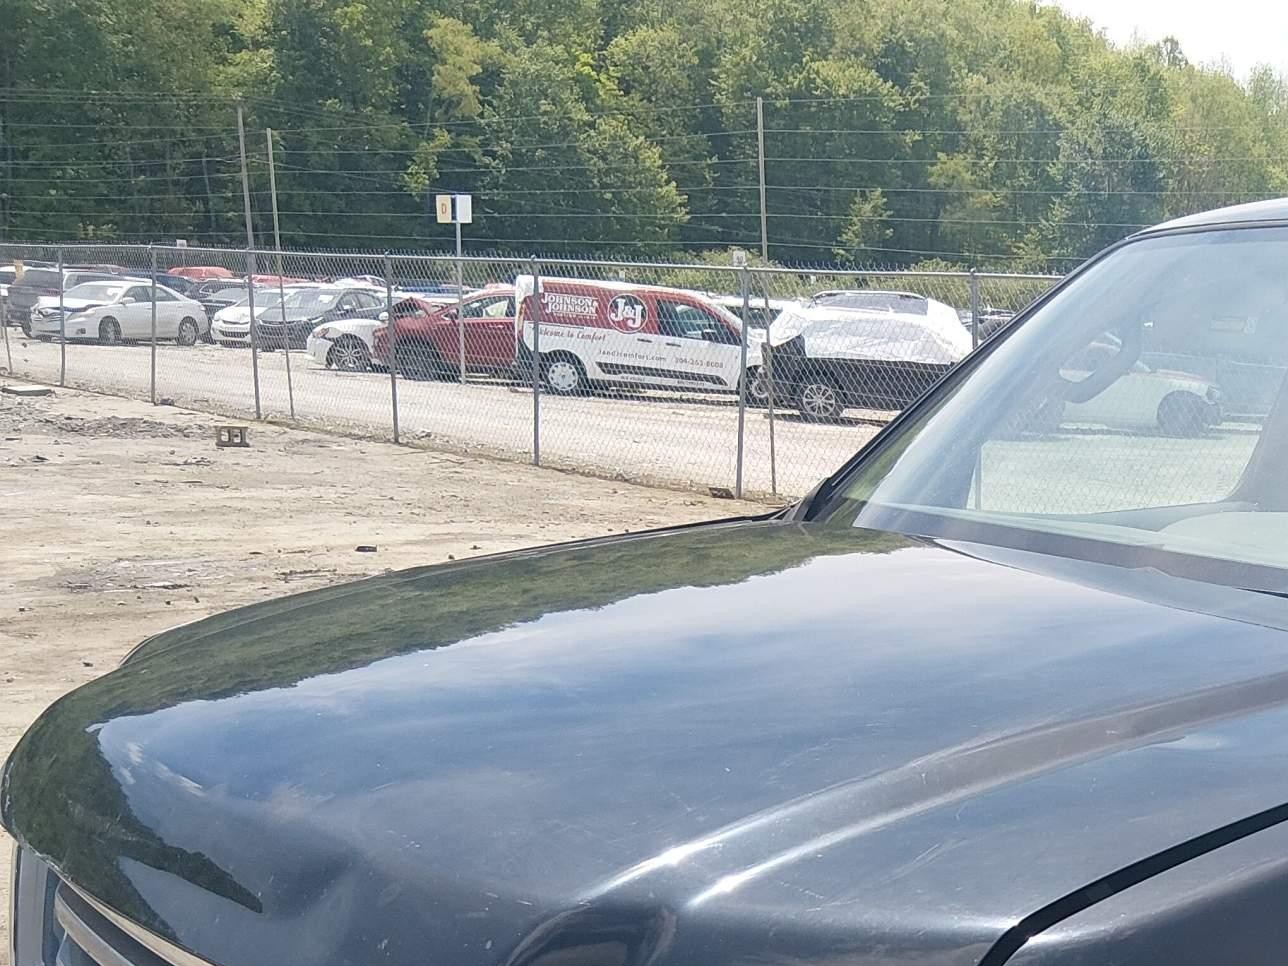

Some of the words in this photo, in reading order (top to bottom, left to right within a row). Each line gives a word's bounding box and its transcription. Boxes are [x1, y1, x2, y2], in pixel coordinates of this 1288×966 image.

[541, 292, 593, 307] JOHNSON
[545, 302, 596, 314] JOHNSON
[610, 298, 644, 328] J&J
[566, 330, 574, 338] to
